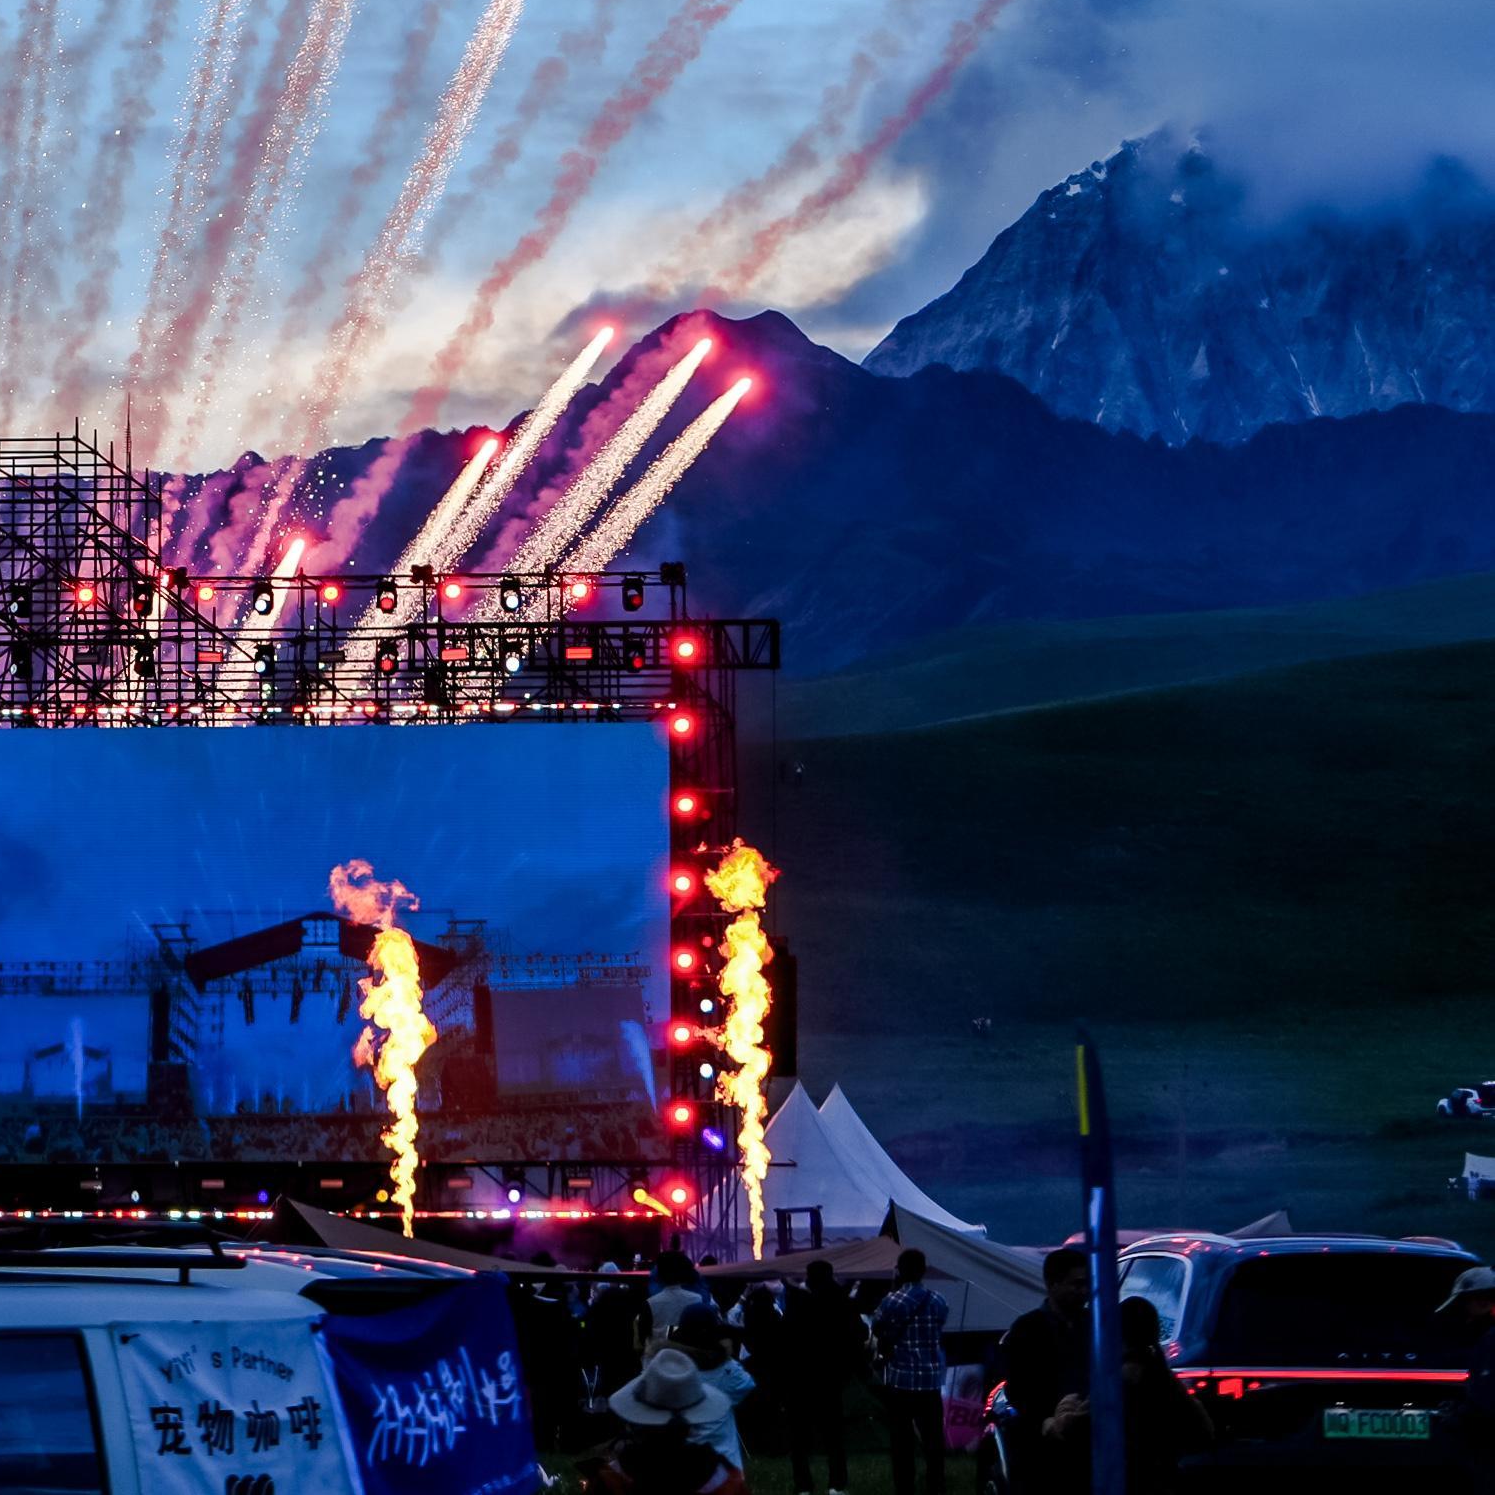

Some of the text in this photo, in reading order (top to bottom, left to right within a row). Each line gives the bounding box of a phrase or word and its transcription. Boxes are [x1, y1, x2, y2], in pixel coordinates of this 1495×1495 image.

[231, 1345, 296, 1383] Partner
[1337, 1352, 1418, 1362] AITO
[149, 1395, 323, 1457] 宠物咖啡
